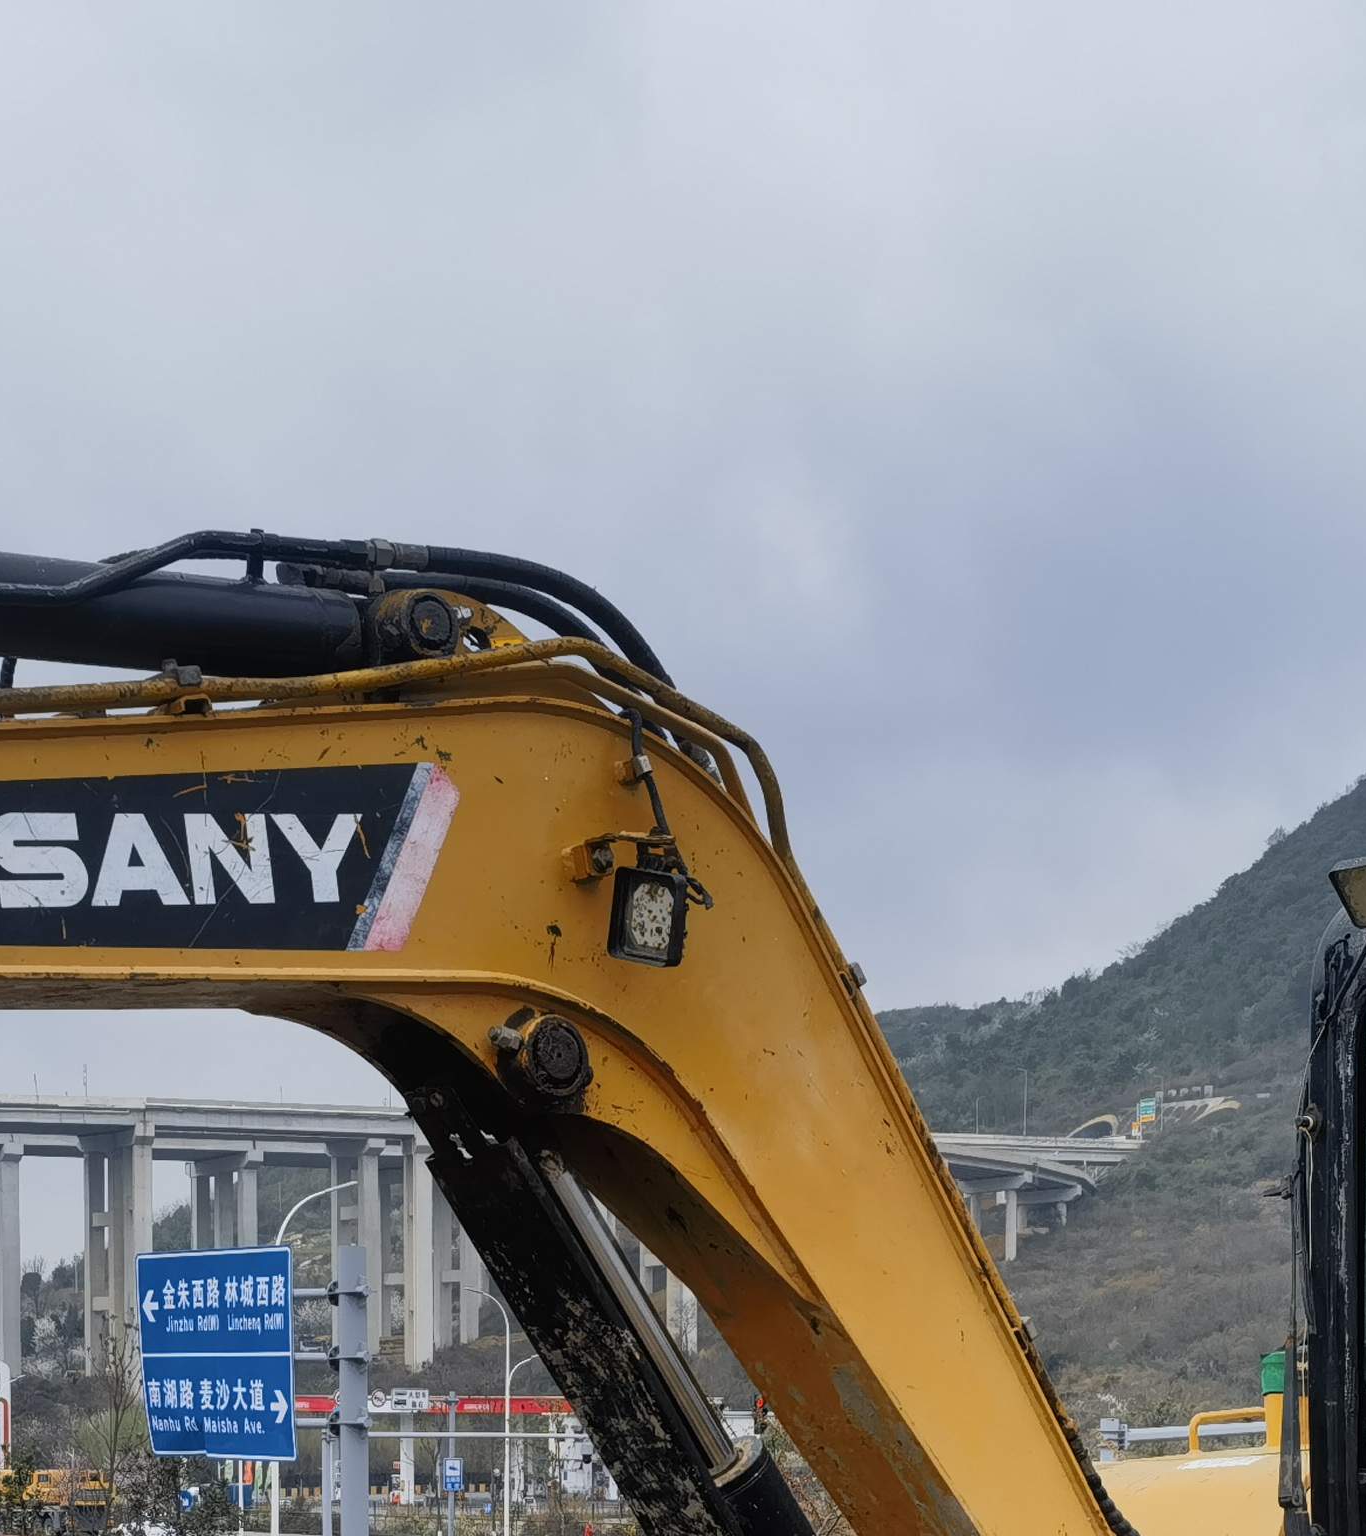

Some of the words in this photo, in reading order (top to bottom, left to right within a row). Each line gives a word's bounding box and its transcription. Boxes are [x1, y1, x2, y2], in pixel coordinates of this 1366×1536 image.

[162, 1276, 220, 1310] 金朱西路
[224, 1274, 285, 1309] 林城西路
[166, 1315, 194, 1333] Jinzhu
[227, 1313, 262, 1335] Lincheng
[147, 1378, 194, 1410] 南湖路
[199, 1378, 266, 1411] 麦沙大道
[151, 1415, 181, 1432] Nanhu
[203, 1416, 239, 1434] Maisha
[244, 1417, 266, 1434] Ave.
